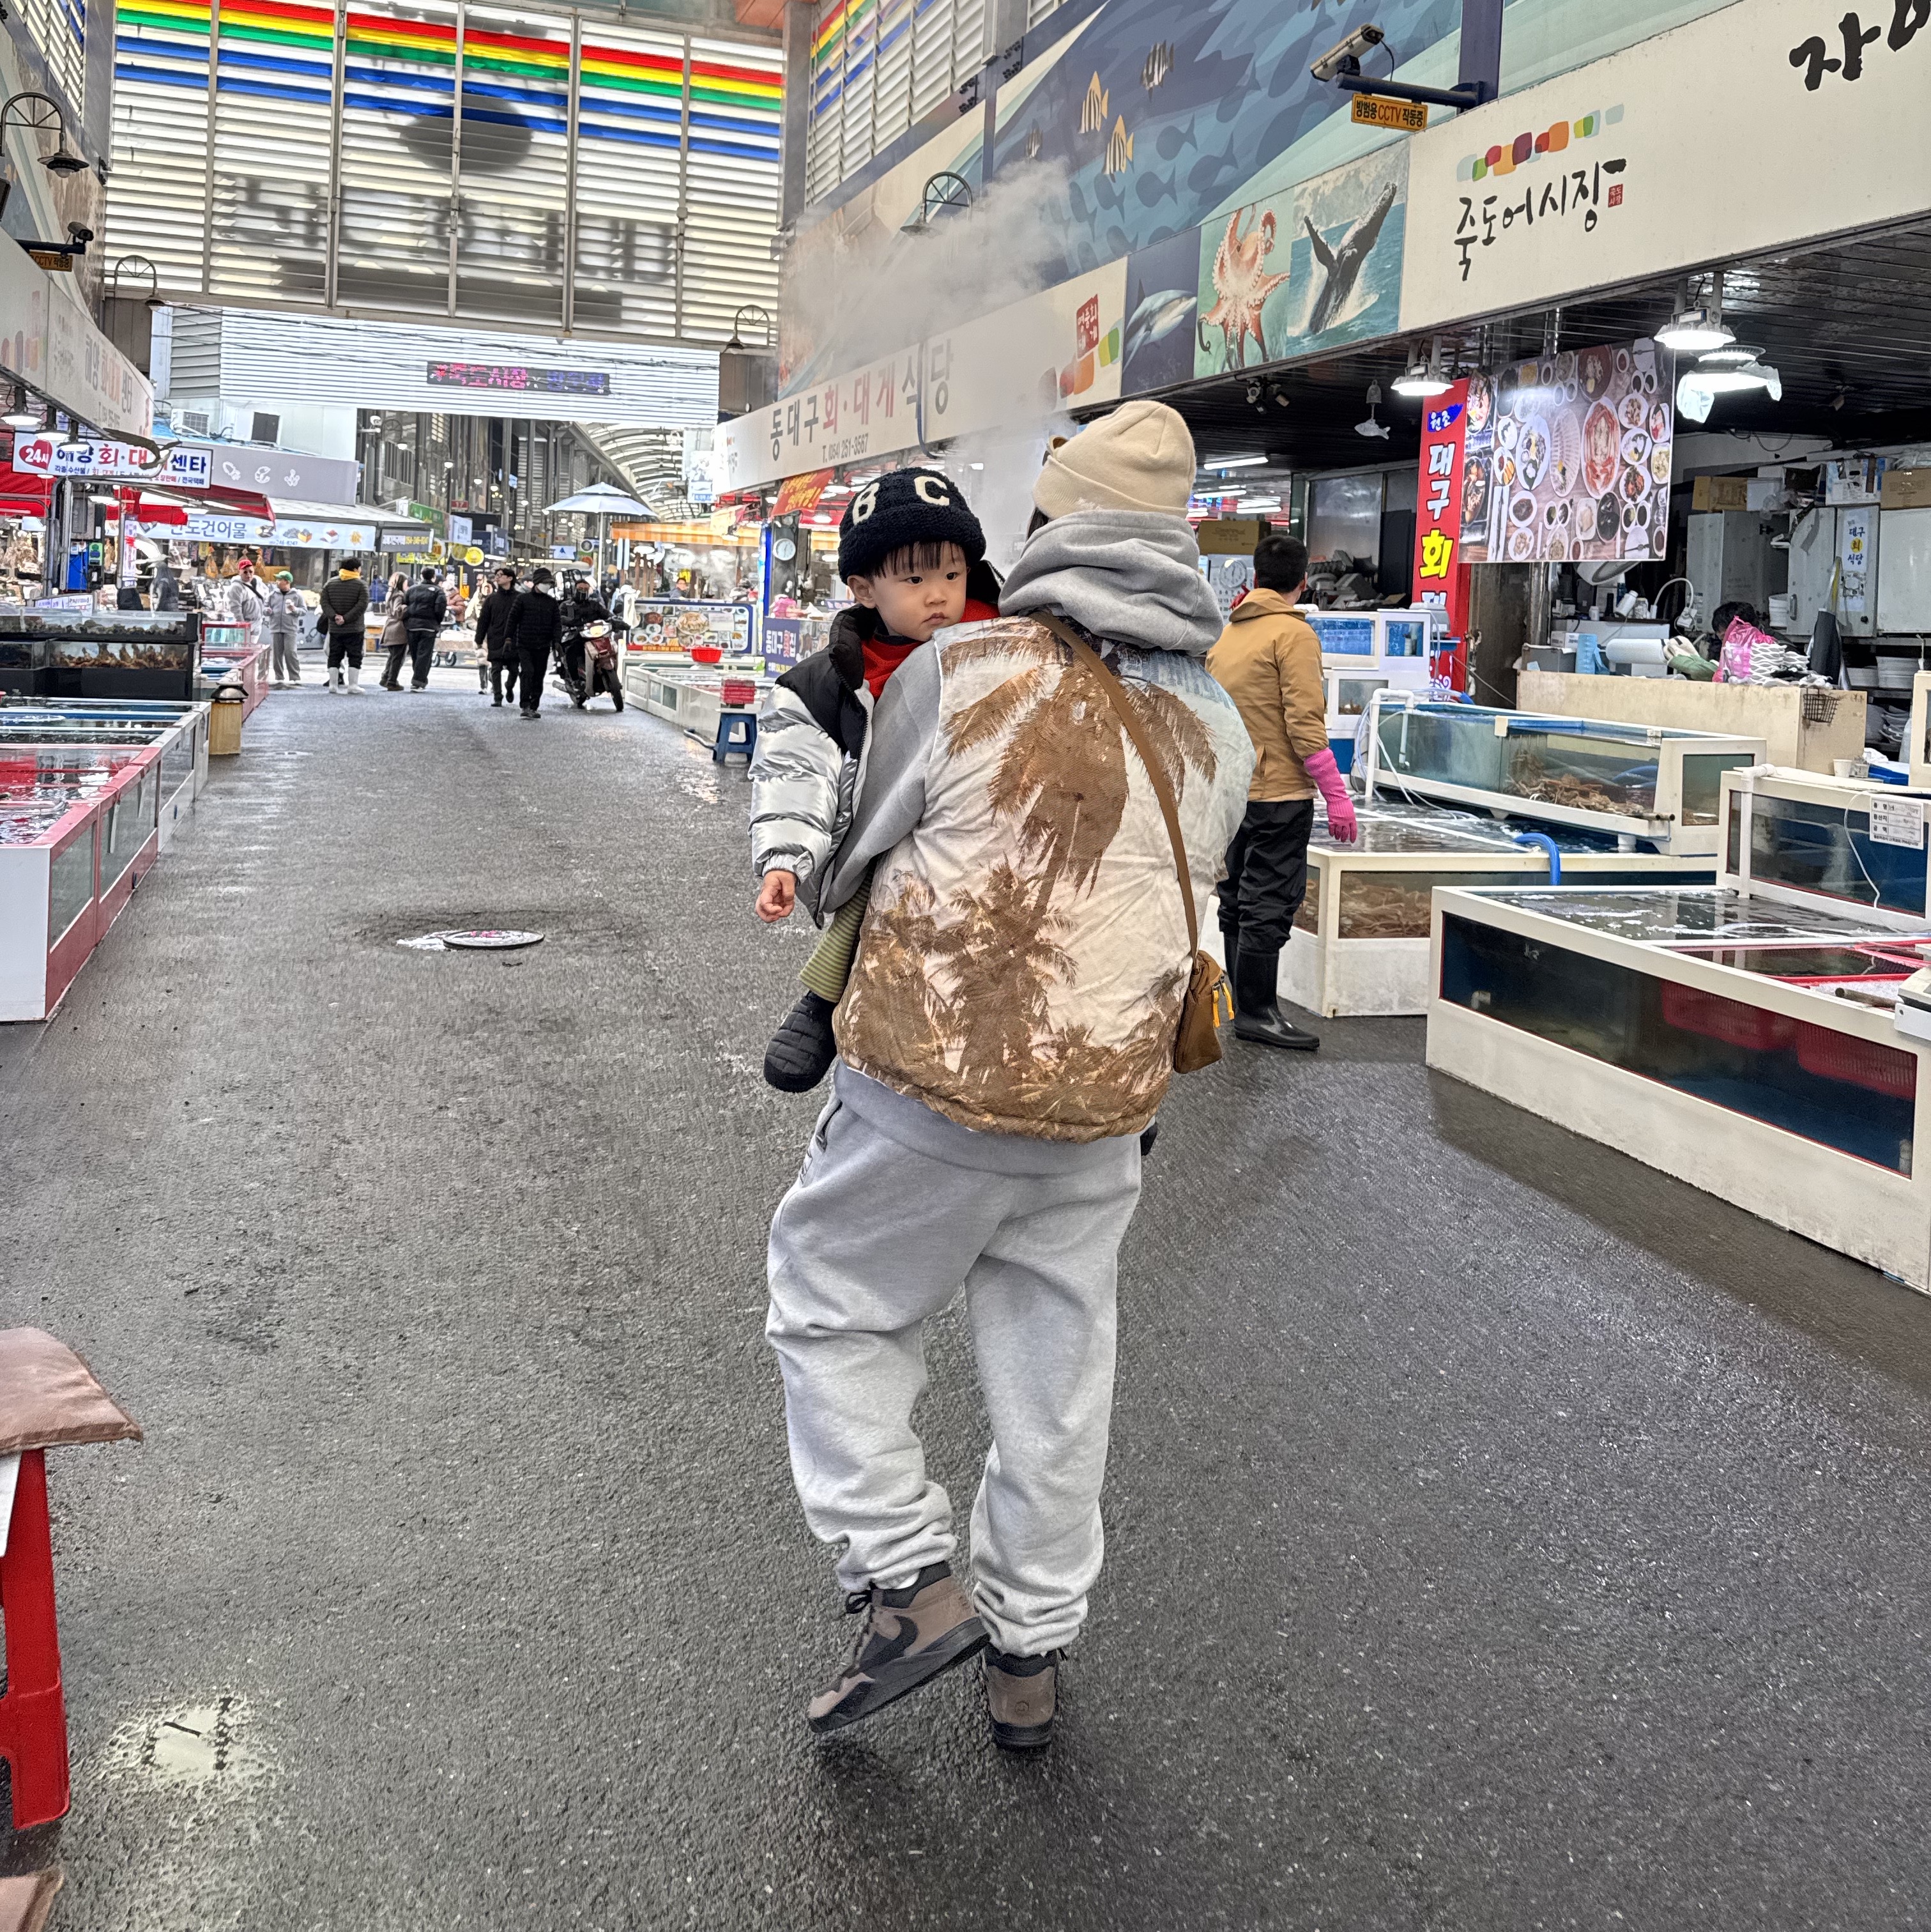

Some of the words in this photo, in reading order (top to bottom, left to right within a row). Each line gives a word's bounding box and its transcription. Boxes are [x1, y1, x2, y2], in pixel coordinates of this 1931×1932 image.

[1356, 100, 1377, 119] 방범용
[1378, 104, 1402, 123] CCTV
[1403, 108, 1423, 127] 작동중
[1430, 408, 1452, 433] 원조
[25, 448, 49, 464] 24시
[852, 482, 880, 525] B
[914, 476, 950, 506] C
[1849, 526, 1865, 537] 대구
[1853, 540, 1860, 551] 회
[1847, 553, 1864, 565] 식당
